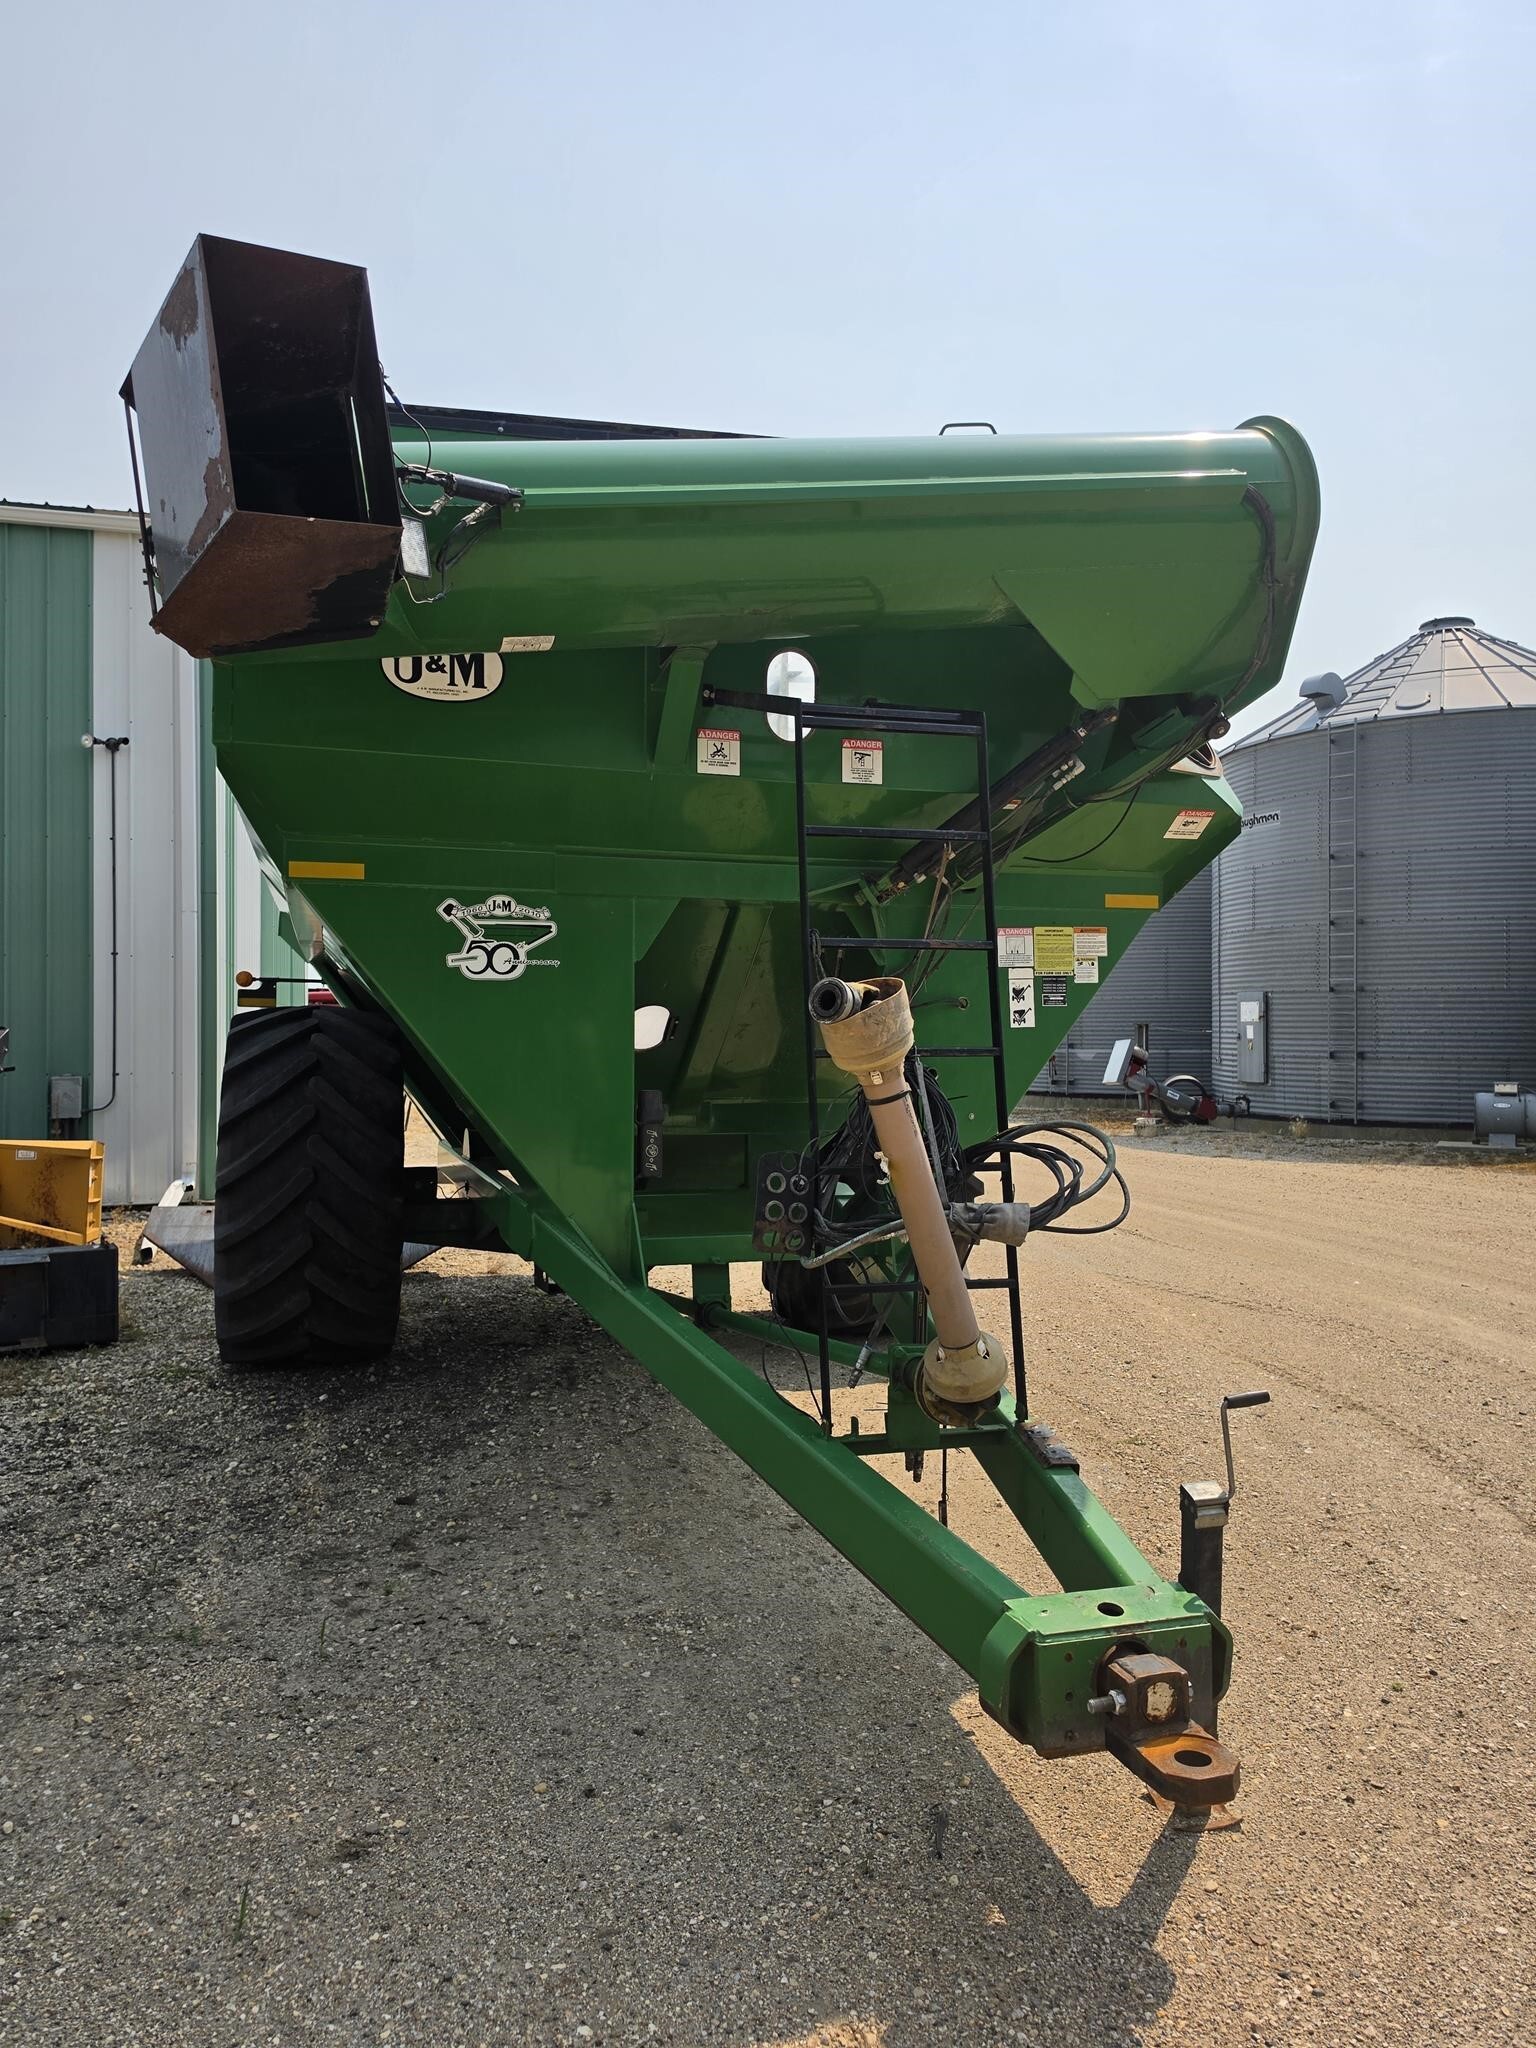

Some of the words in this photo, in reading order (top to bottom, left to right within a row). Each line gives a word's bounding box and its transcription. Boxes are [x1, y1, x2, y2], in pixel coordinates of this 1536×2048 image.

[705, 731, 740, 740] DANGER
[850, 740, 882, 749] DANGER
[1185, 810, 1216, 818] DANGER
[1241, 813, 1279, 829] aughman
[488, 899, 512, 913] J&M
[465, 940, 520, 975] 50
[503, 957, 559, 968] Anniversary
